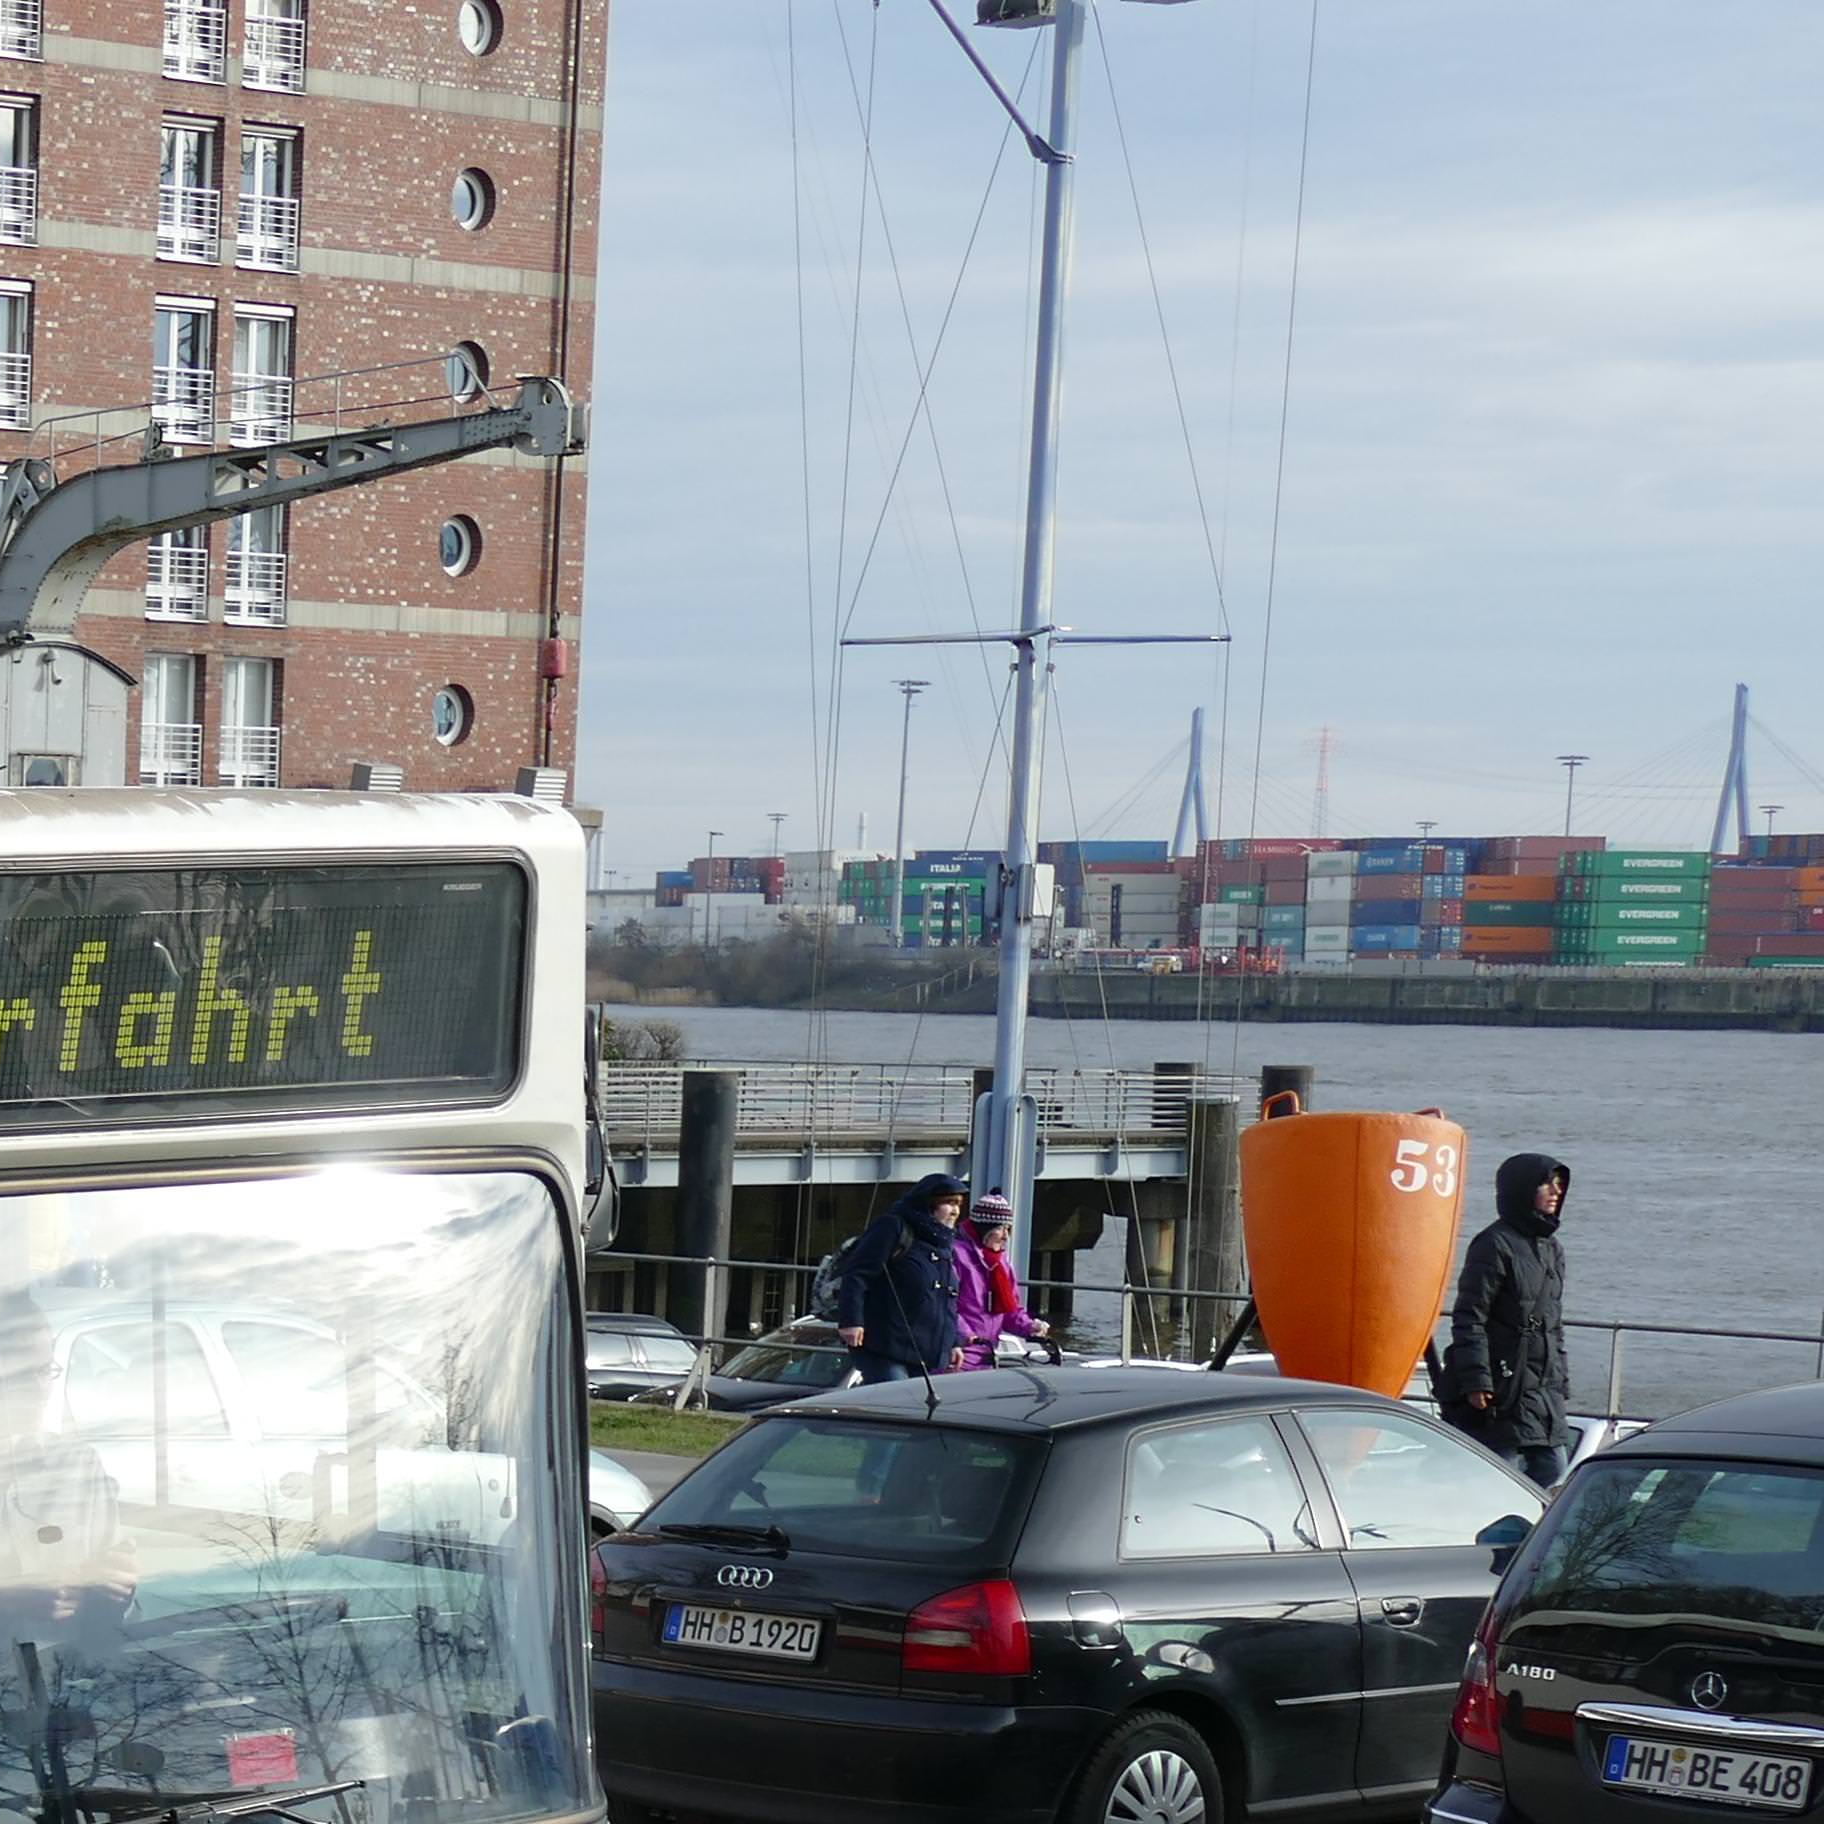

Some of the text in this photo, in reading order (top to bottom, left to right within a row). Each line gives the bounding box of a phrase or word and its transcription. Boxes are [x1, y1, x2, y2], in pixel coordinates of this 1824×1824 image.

[1390, 1139, 1456, 1198] 53
[681, 1609, 817, 1653] HH B 1920
[1506, 1662, 1557, 1681] A180
[1623, 1744, 1802, 1800] HH BE 408
